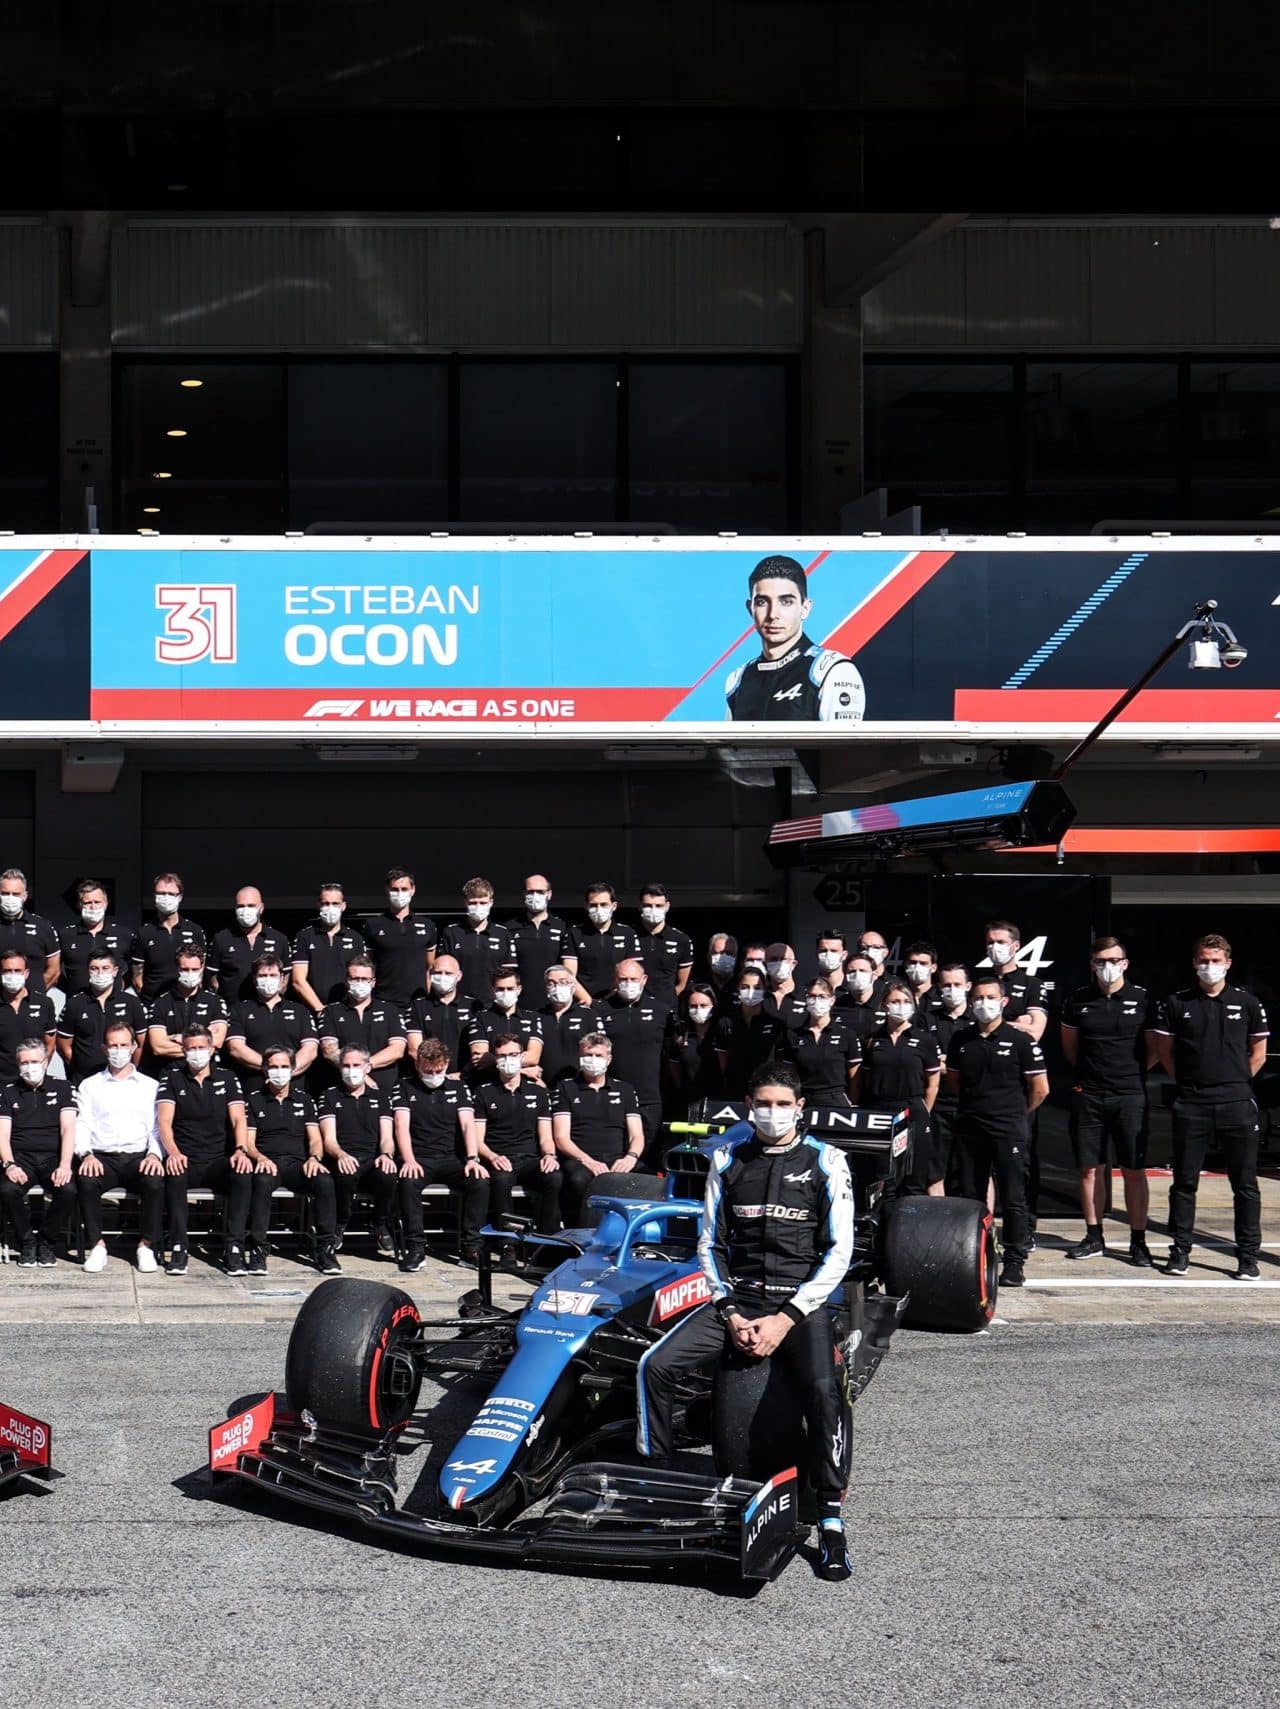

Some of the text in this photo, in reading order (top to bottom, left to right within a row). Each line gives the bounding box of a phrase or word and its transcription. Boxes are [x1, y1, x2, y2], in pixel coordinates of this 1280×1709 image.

[285, 585, 480, 615] ESTEBAN
[155, 583, 237, 664] 31
[284, 624, 458, 666] OCON
[370, 699, 412, 717] WE
[415, 699, 478, 717] RACE
[482, 699, 518, 717] AS
[521, 699, 575, 717] ONE
[825, 880, 861, 905] 25
[711, 1105, 894, 1130] AINE
[766, 1203, 810, 1222] EDGE
[538, 1289, 601, 1316] 31
[0, 1427, 32, 1451] POWER
[9, 1418, 32, 1438] PLUG
[222, 1423, 242, 1444] PLUG
[213, 1437, 242, 1461] POWER
[746, 1493, 791, 1553] ALPINE
